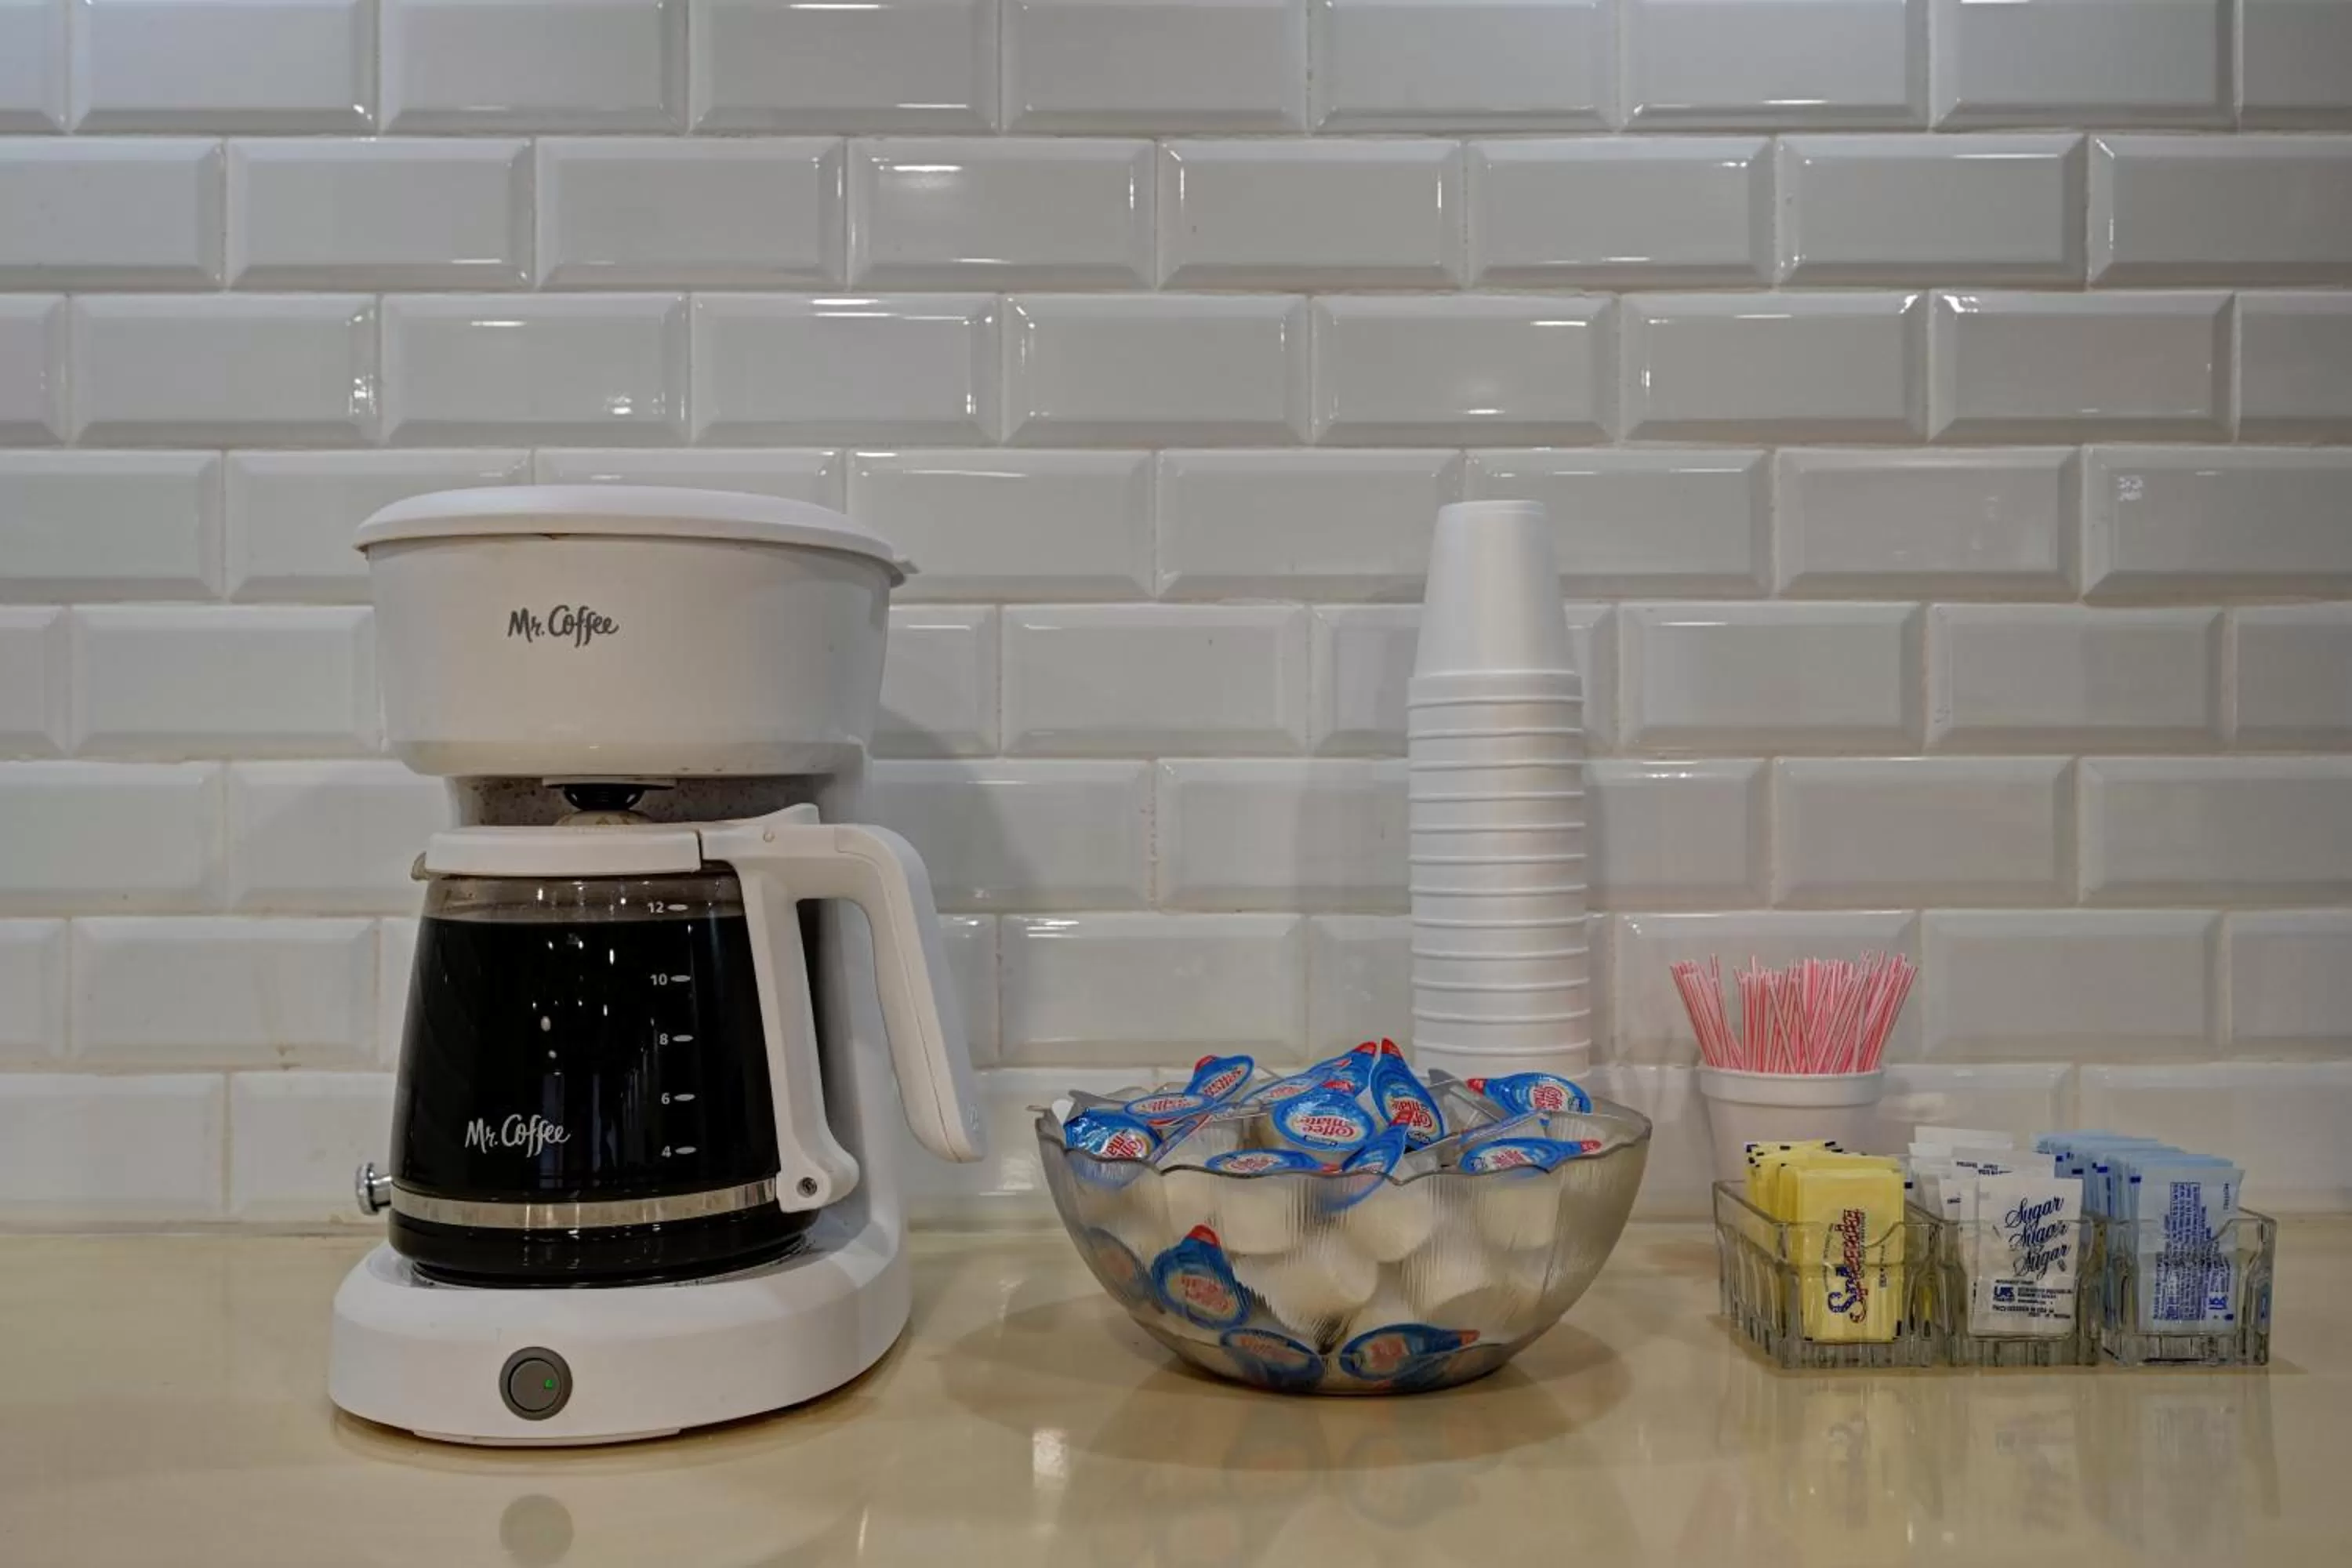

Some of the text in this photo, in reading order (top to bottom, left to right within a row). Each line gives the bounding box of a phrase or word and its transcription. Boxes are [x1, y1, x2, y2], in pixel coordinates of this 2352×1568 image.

[508, 604, 619, 648] Mr. Coffee
[648, 902, 664, 913] 12
[650, 973, 667, 985] 10
[659, 1033, 669, 1045] 8
[661, 1093, 670, 1105] 6
[465, 1113, 571, 1158] Mr. Coffee
[1301, 1126, 1354, 1137] Coffee
[661, 1145, 671, 1157] 4
[2004, 1196, 2064, 1229] Sugar
[1828, 1209, 1868, 1323] Splenda
[2013, 1244, 2071, 1280] Sugar
